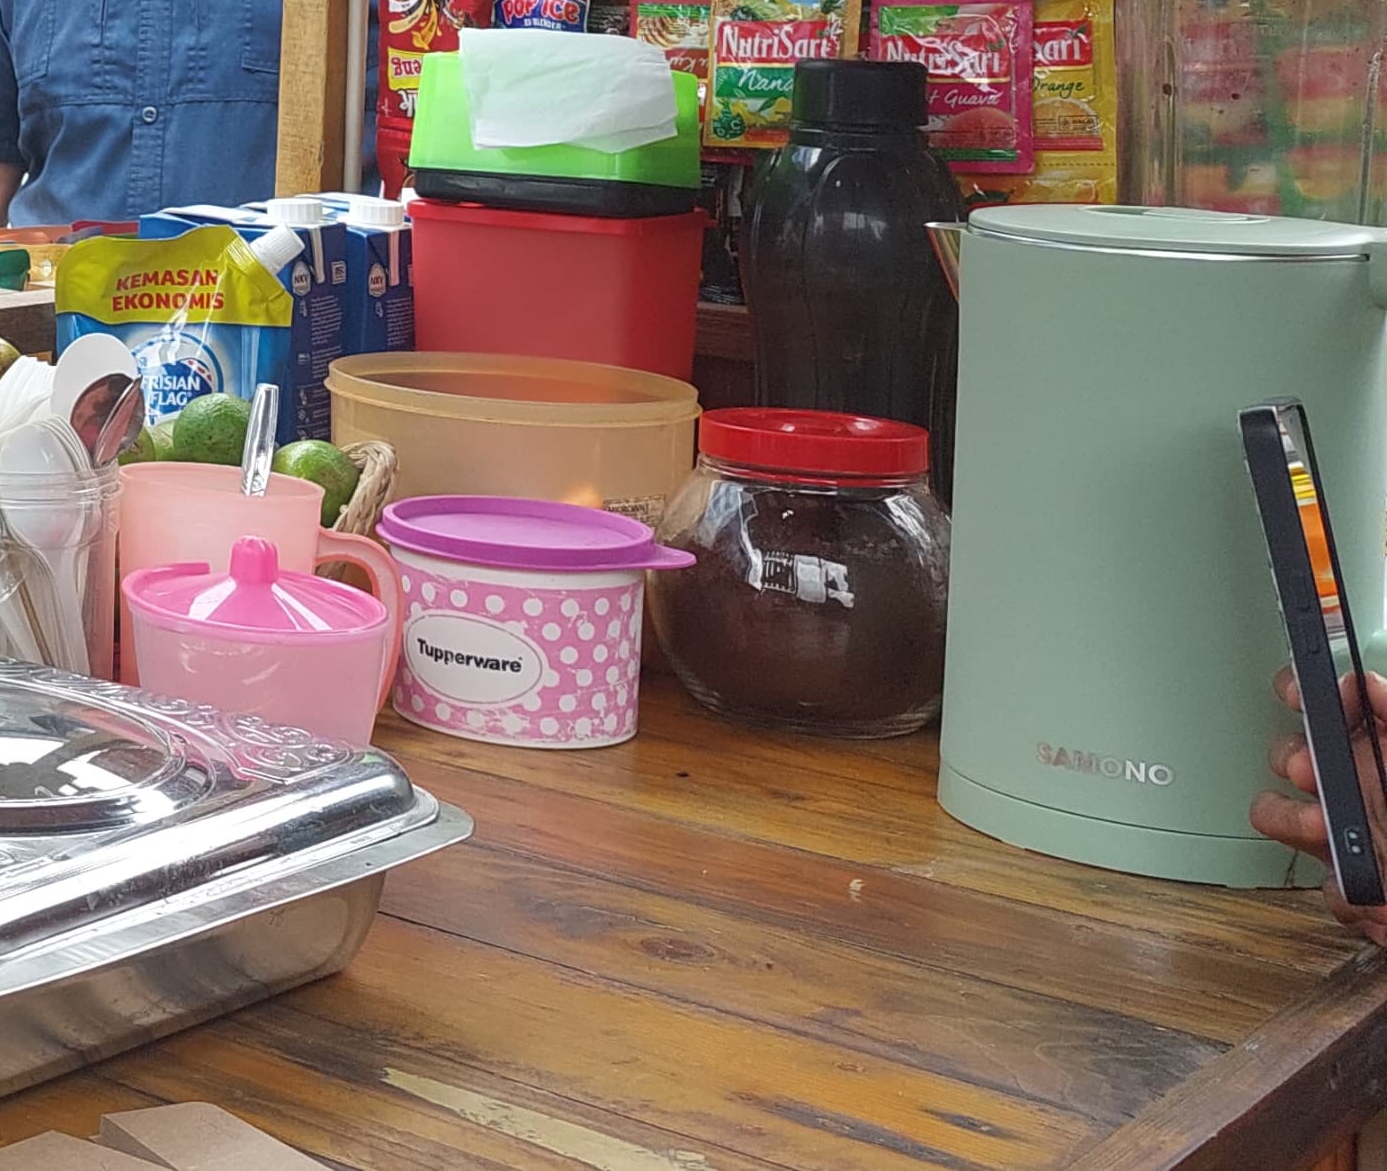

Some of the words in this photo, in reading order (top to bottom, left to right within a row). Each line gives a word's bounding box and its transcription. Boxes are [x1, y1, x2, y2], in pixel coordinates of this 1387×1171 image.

[721, 24, 830, 60] NutriSari
[738, 68, 794, 91] Nana
[944, 89, 1001, 106] Guava
[115, 268, 220, 292] KEMASAN
[111, 291, 226, 313] EKONOMIS
[417, 637, 523, 673] Tupperware
[1037, 740, 1174, 786] SAMONO
